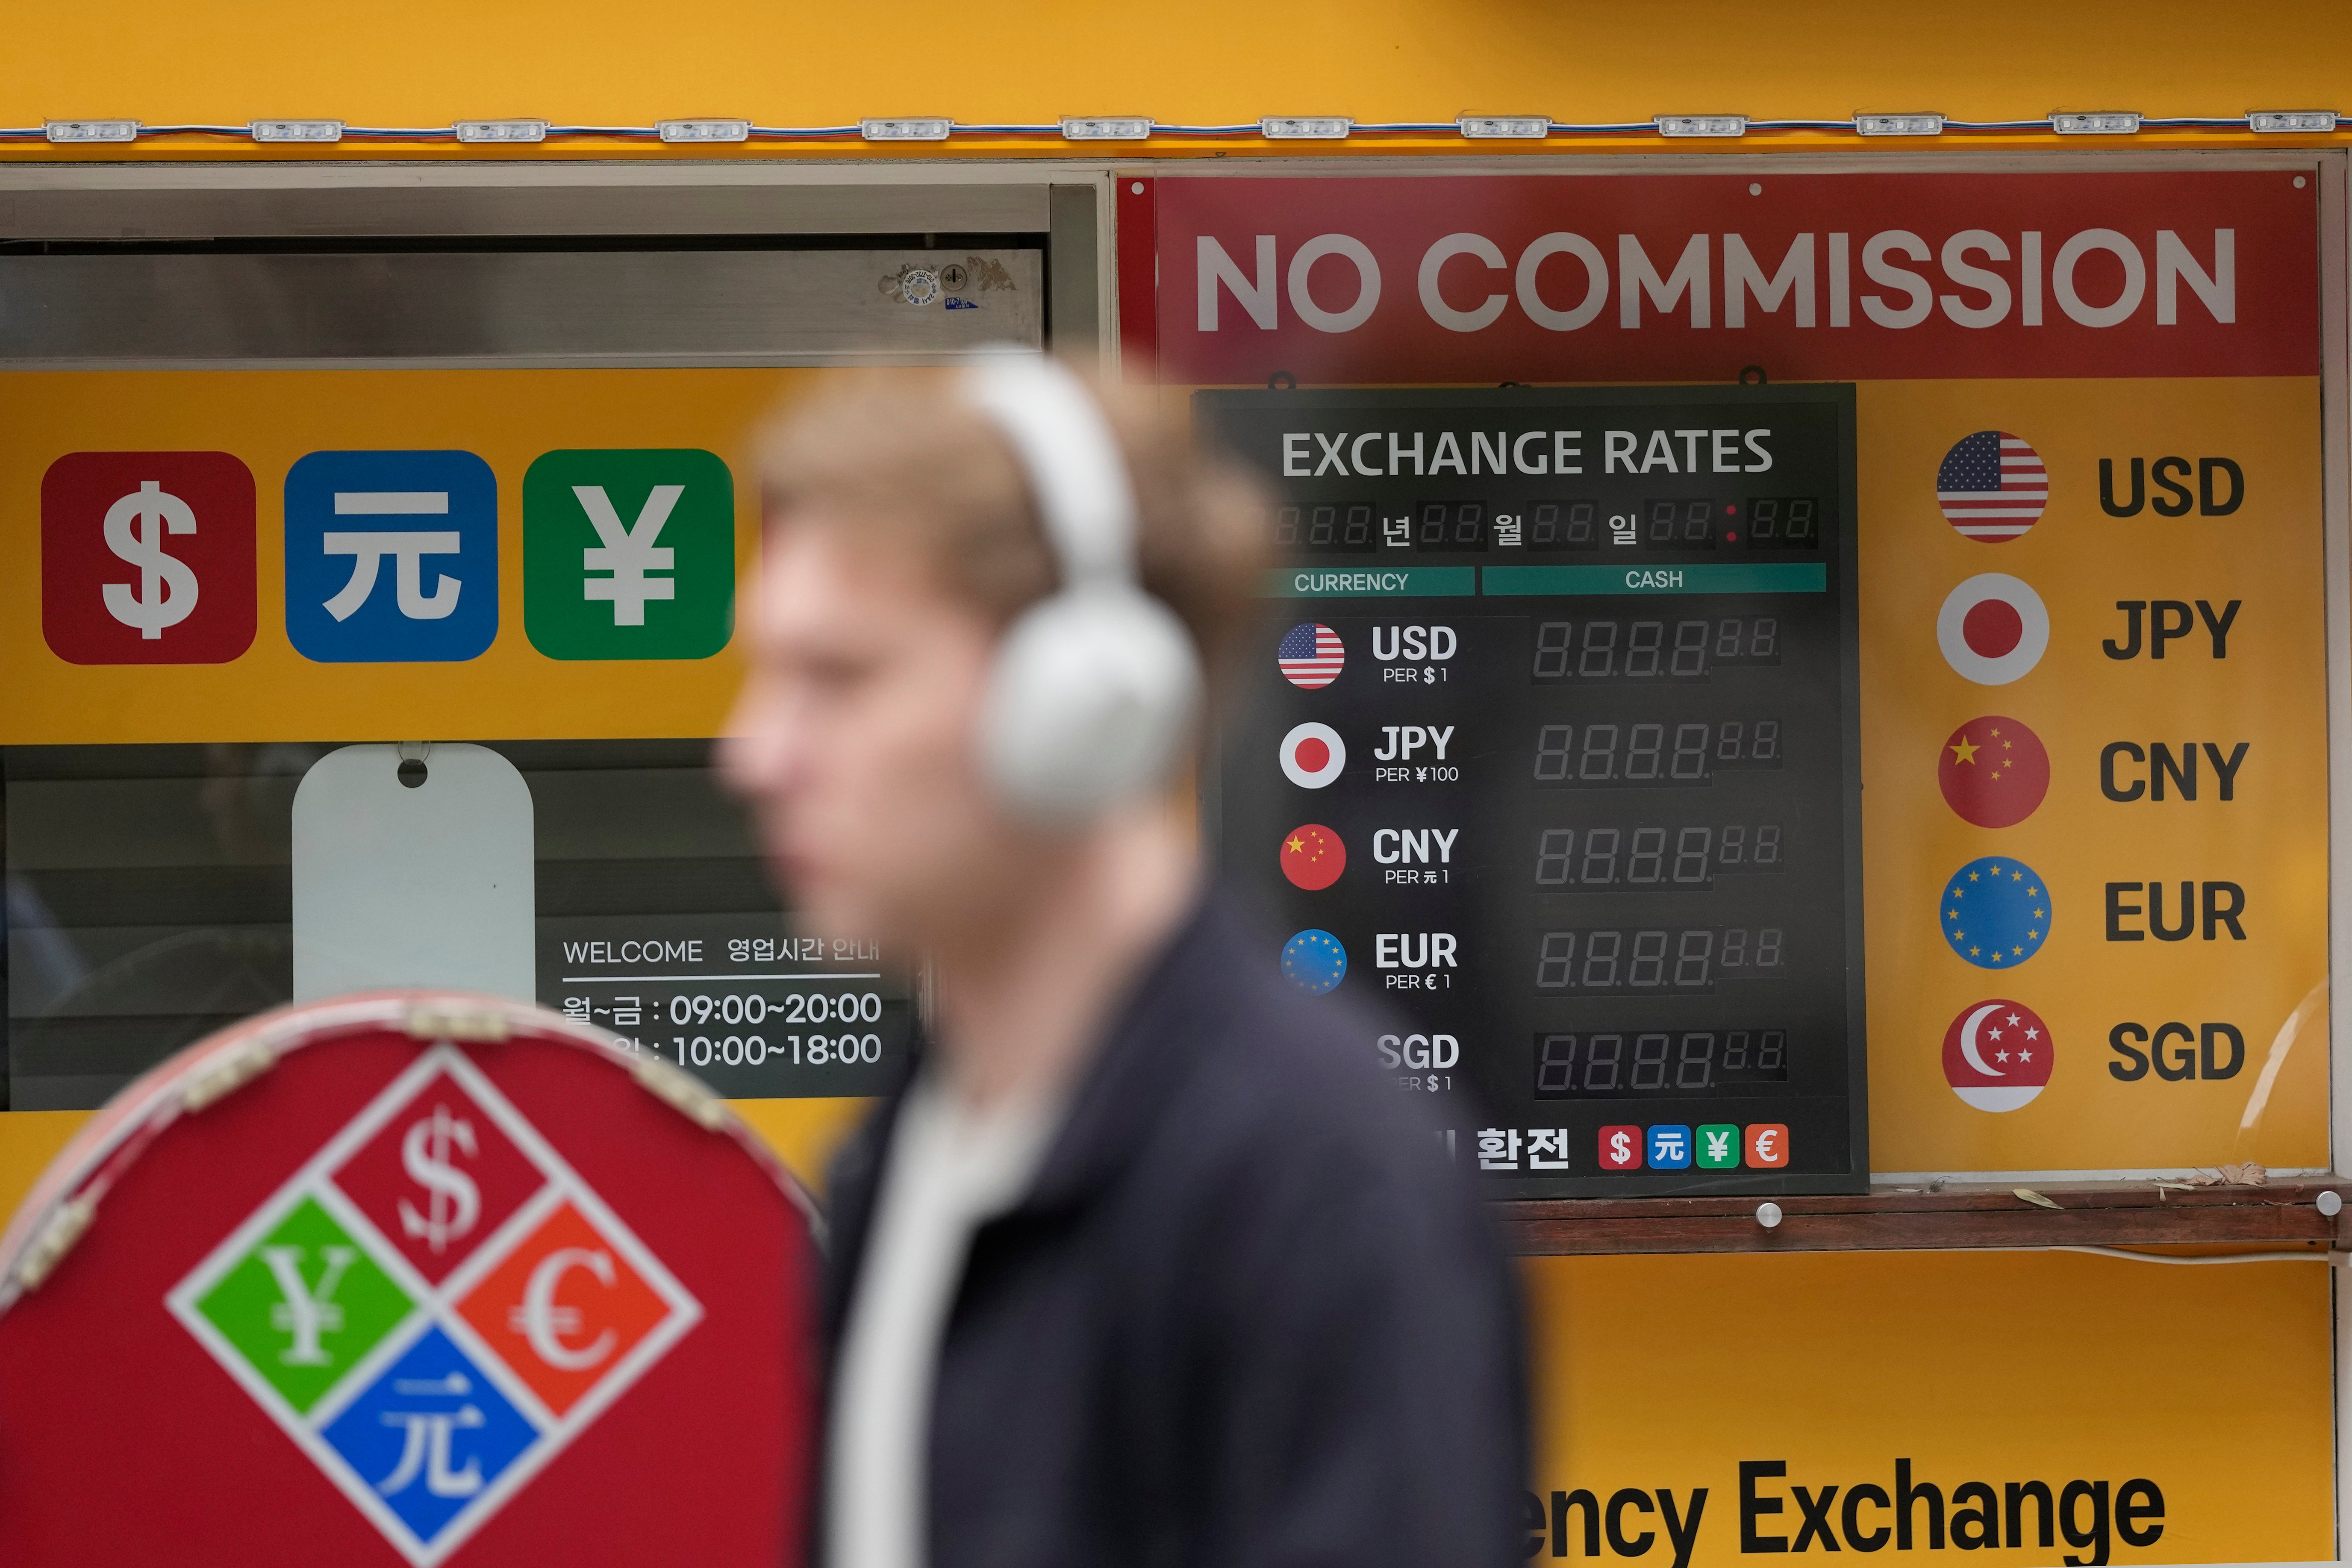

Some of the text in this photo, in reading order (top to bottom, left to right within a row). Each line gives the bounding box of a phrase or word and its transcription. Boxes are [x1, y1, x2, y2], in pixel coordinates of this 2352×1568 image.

[1197, 228, 2235, 333] NO COMMISSION
[1283, 429, 1772, 477] EXCHANGE RATES
[2099, 456, 2244, 518] USD
[1383, 514, 1637, 547] 년 월 일
[102, 480, 199, 640] $
[322, 491, 462, 623] 元
[571, 485, 686, 626] ¥
[1294, 573, 1409, 592] CURRENCY
[1625, 571, 1683, 588] CASH
[1372, 625, 1457, 661] USD
[2102, 600, 2242, 660] JPY
[1384, 666, 1446, 685] PER $ 1
[1374, 726, 1454, 761] JPY
[1376, 768, 1410, 782] PER
[2100, 741, 2250, 802] CNY
[1373, 829, 1459, 864] CNY
[1385, 869, 1448, 884] PER 元 1
[2105, 881, 2247, 941] EUR
[563, 937, 880, 963] WELCOME 영업시간 안내
[1376, 933, 1457, 968] EUR
[1386, 974, 1449, 990] PER € 1
[670, 993, 881, 1025] 09:00~20:00
[673, 1034, 881, 1066] 10:00~18:00
[1377, 1034, 1460, 1069] SGD
[2108, 1022, 2245, 1082] SGD
[1427, 1074, 1439, 1093] $
[1444, 1077, 1451, 1090] 1
[1477, 1128, 1569, 1170] 환전
[1610, 1131, 1631, 1165] $
[1655, 1133, 1684, 1161] 元
[1706, 1131, 1729, 1162] ¥
[1756, 1130, 1778, 1162] €
[397, 1103, 481, 1252] $
[261, 1244, 359, 1367] ¥
[510, 1246, 617, 1371] €
[378, 1372, 485, 1497] 元
[1739, 1458, 2165, 1566] Exchange
